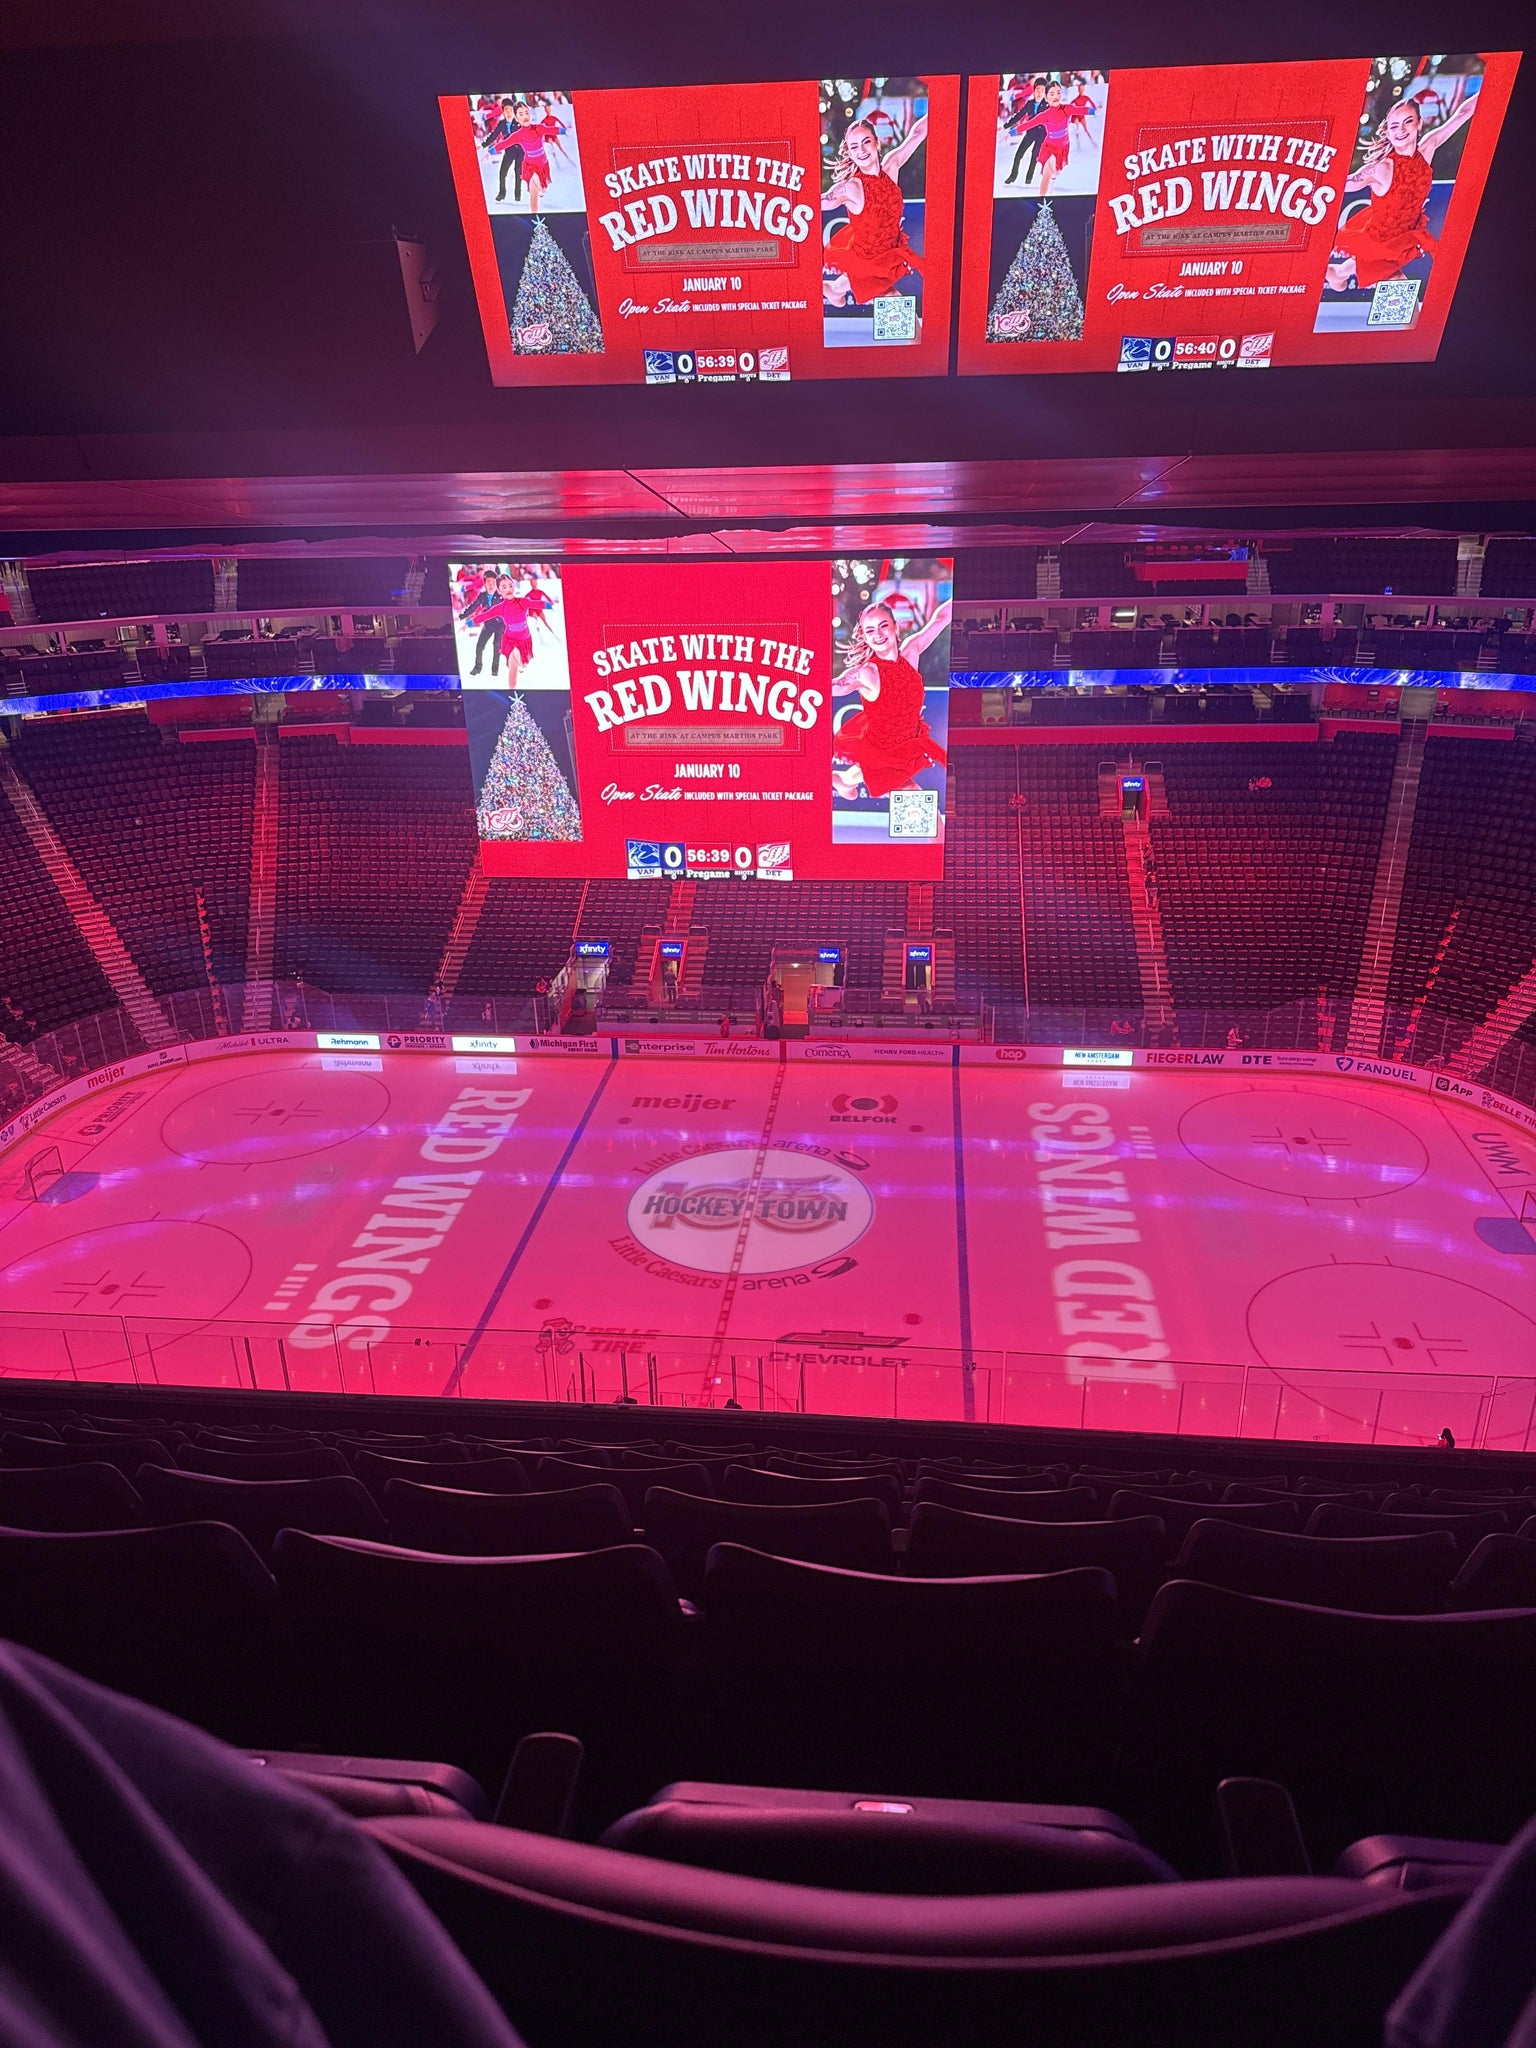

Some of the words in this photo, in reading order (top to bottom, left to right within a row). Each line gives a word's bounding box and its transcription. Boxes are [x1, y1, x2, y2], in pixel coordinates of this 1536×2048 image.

[1124, 137, 1206, 181] SKATE
[1211, 134, 1283, 162] WITH
[1284, 137, 1337, 173] THE
[605, 157, 681, 198] SKATE
[682, 153, 751, 180] WITH
[756, 157, 805, 191] THE
[1108, 176, 1193, 236] RED
[1201, 169, 1336, 226] WINGS
[599, 194, 678, 251] RED
[681, 188, 814, 243] WINGS
[1179, 262, 1229, 277] JANUARY
[1231, 261, 1243, 275] 10
[682, 277, 727, 292] JANUARY
[730, 276, 742, 290] 10
[1106, 283, 1139, 306] Open
[1143, 282, 1185, 300] Skate
[1185, 289, 1214, 297] INCLUDED
[1215, 288, 1232, 296] WITH
[1233, 287, 1256, 296] SPECIAL
[1258, 286, 1277, 295] TICKET
[1279, 285, 1306, 294] PACKAGE
[618, 298, 649, 320] Open
[653, 298, 691, 314] Skate
[693, 303, 720, 312] INCLUDED
[721, 303, 737, 311] WITH
[738, 302, 760, 311] SPECIAL
[761, 301, 780, 310] TICKET
[781, 301, 807, 309] PACKAGE
[1155, 340, 1171, 360] 0
[1176, 342, 1216, 355] 56:40
[1219, 338, 1236, 358] 0
[677, 354, 693, 373] 0
[697, 355, 735, 368] 56:39
[739, 352, 754, 372] 0
[1172, 361, 1213, 370] Pregame
[698, 374, 736, 383] Pregame
[592, 636, 677, 677] SKATE
[679, 634, 755, 662] WITH
[760, 638, 815, 676] THE
[583, 674, 672, 733] RED
[676, 669, 824, 730] WINGS
[674, 764, 724, 778] JANUARY
[728, 763, 740, 778] 10
[601, 783, 635, 806] Open
[640, 784, 683, 801] Skate
[684, 792, 715, 801] INCLUDED
[716, 792, 734, 801] WITH
[735, 792, 760, 801] SPECIAL
[762, 792, 783, 801] TICKET
[785, 792, 814, 801] PACKAGE
[664, 846, 682, 868] 0
[687, 849, 730, 863] 56:39
[735, 846, 752, 868] 0
[686, 870, 730, 879] Pregame
[580, 944, 606, 954] xfinity
[820, 951, 838, 959] xfinity
[258, 1037, 290, 1045] ULTRA
[331, 1038, 369, 1046] Rehmann
[470, 1040, 498, 1049] xfinity
[540, 1039, 577, 1049] Michigan
[579, 1040, 598, 1048] First
[629, 1041, 694, 1052] enterprise
[704, 1042, 725, 1055] Tim
[725, 1043, 770, 1056] Hortons
[1242, 1055, 1272, 1065] DTE
[87, 1066, 126, 1088] meijer
[1356, 1062, 1417, 1082] FANDUEL
[29, 1107, 44, 1122] Little
[43, 1094, 67, 1111] Caesars
[632, 1094, 736, 1112] meijer
[1492, 1100, 1522, 1118] BELLE
[420, 1088, 533, 1163] RED
[830, 1115, 897, 1124] BELFOR
[632, 1151, 682, 1175] Little
[774, 1140, 831, 1156] arena
[1027, 1102, 1142, 1250] WINGS
[288, 1170, 484, 1350] WINGS
[608, 1235, 648, 1267] Little
[644, 1260, 723, 1289] Caesars
[742, 1272, 810, 1290] arena
[1064, 1259, 1177, 1389] RED
[591, 1340, 646, 1353] TIRE
[768, 1351, 911, 1368] CHEVROLET
